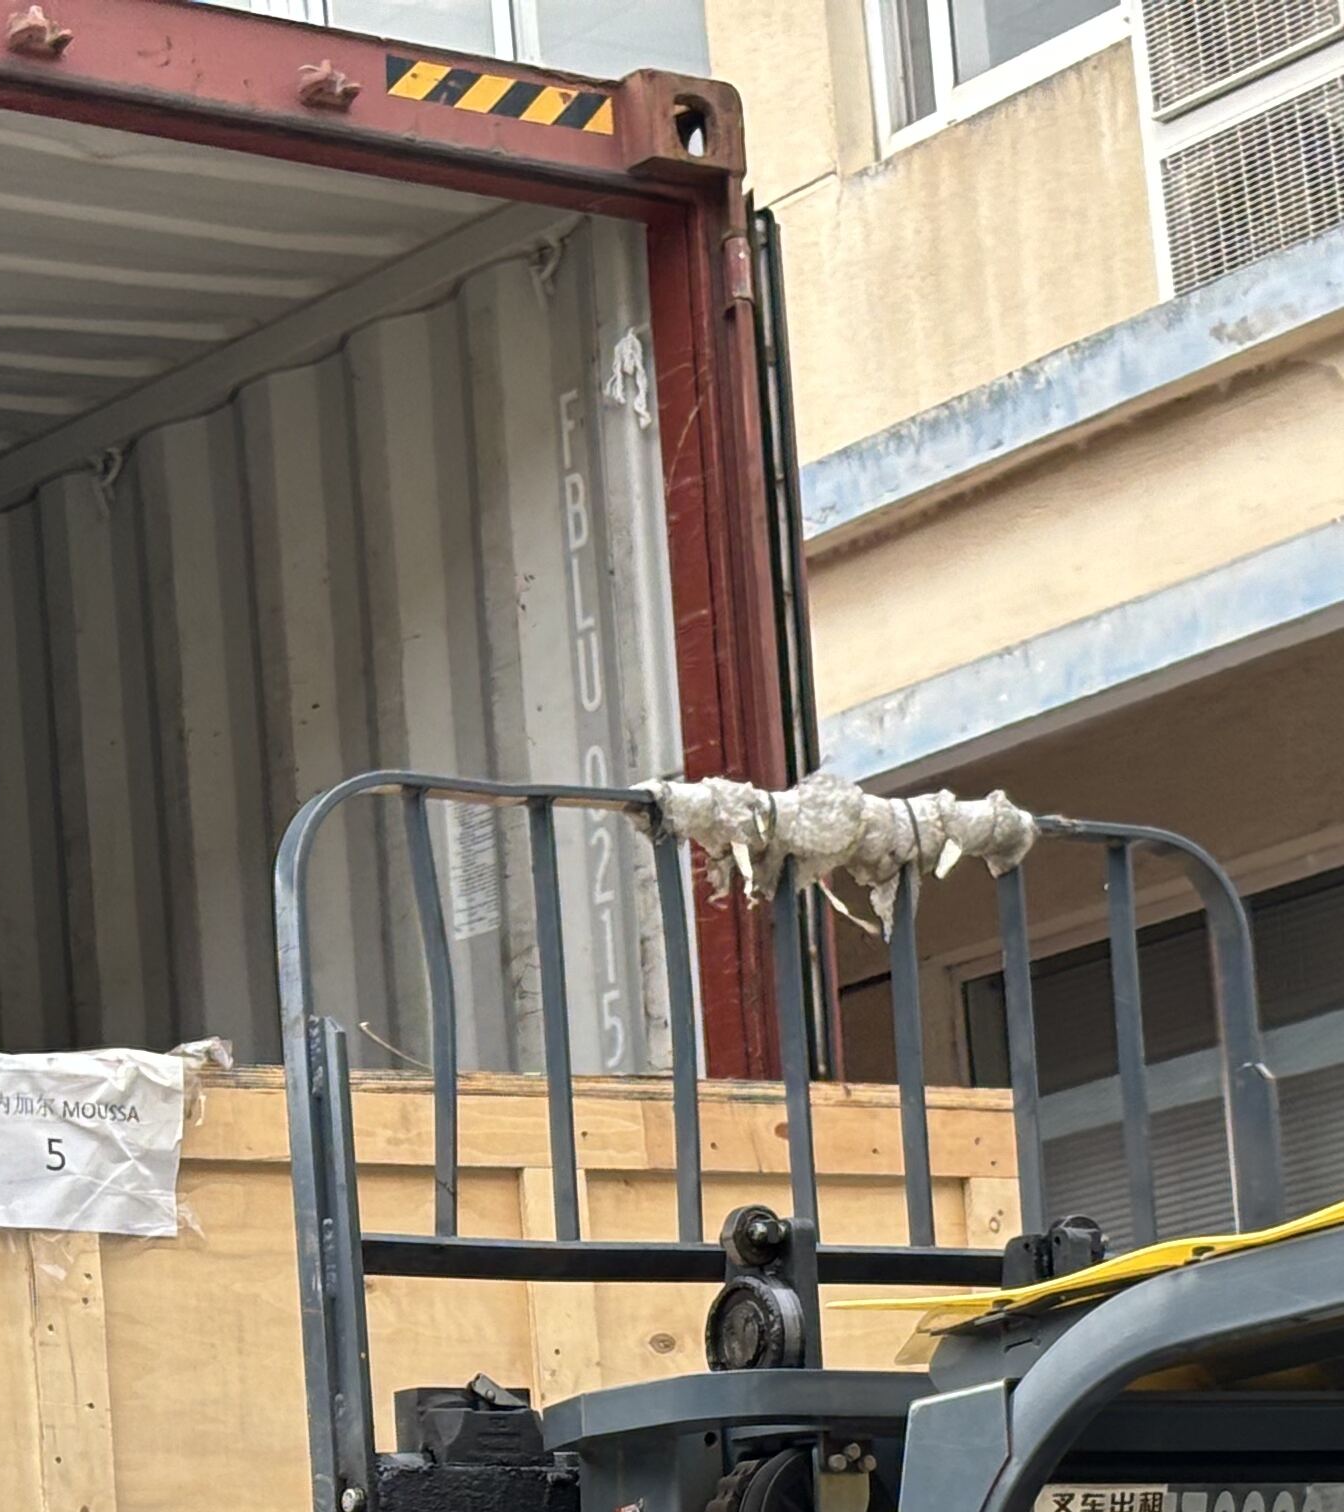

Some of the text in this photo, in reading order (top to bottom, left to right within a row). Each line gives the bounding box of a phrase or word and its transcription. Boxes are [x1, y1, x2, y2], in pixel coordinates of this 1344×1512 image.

[560, 388, 605, 714] FBLU
[62, 1099, 140, 1124] MOUSSA
[46, 1137, 67, 1171] 5
